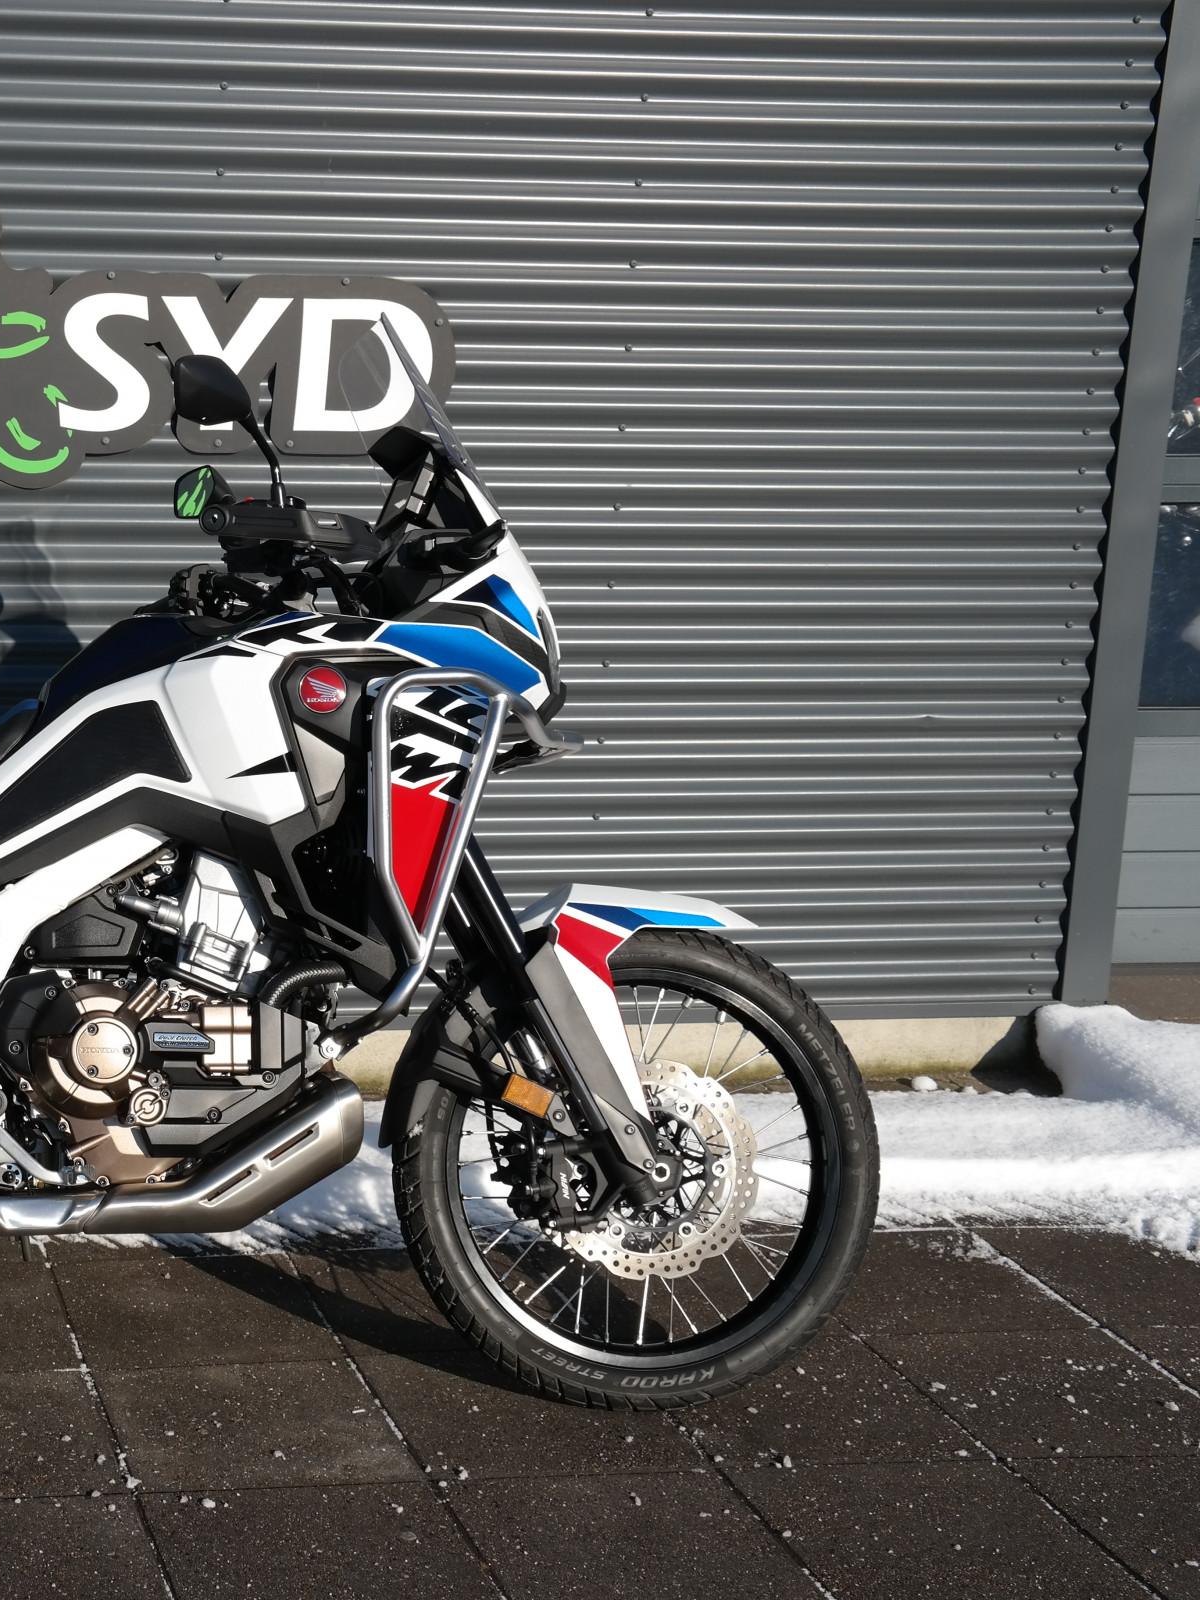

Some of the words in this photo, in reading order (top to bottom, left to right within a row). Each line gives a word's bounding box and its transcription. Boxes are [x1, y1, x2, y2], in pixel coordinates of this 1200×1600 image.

[59, 292, 434, 432] SYD
[797, 1023, 856, 1131] METZELER
[531, 1347, 608, 1381] STREET
[620, 1365, 716, 1389] KAROO
